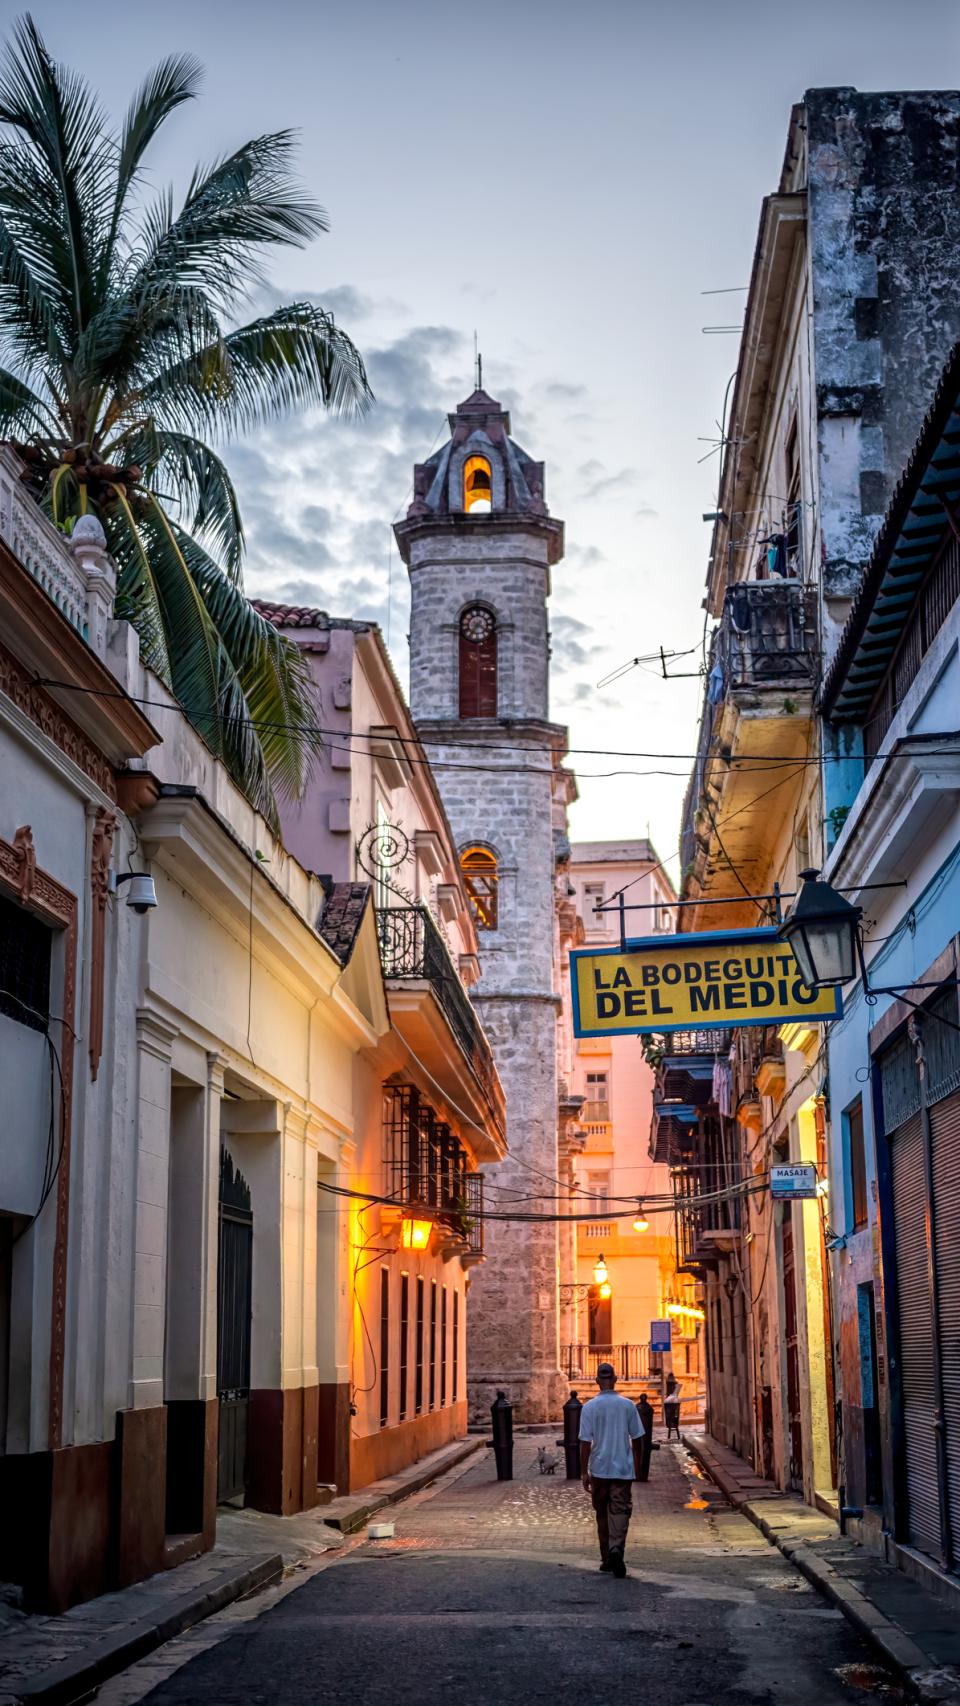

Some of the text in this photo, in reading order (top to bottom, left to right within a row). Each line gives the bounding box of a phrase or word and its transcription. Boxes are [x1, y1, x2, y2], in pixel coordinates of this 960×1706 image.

[594, 956, 803, 989] LA BODEGUIT
[596, 979, 819, 1019] DEL MEDIO
